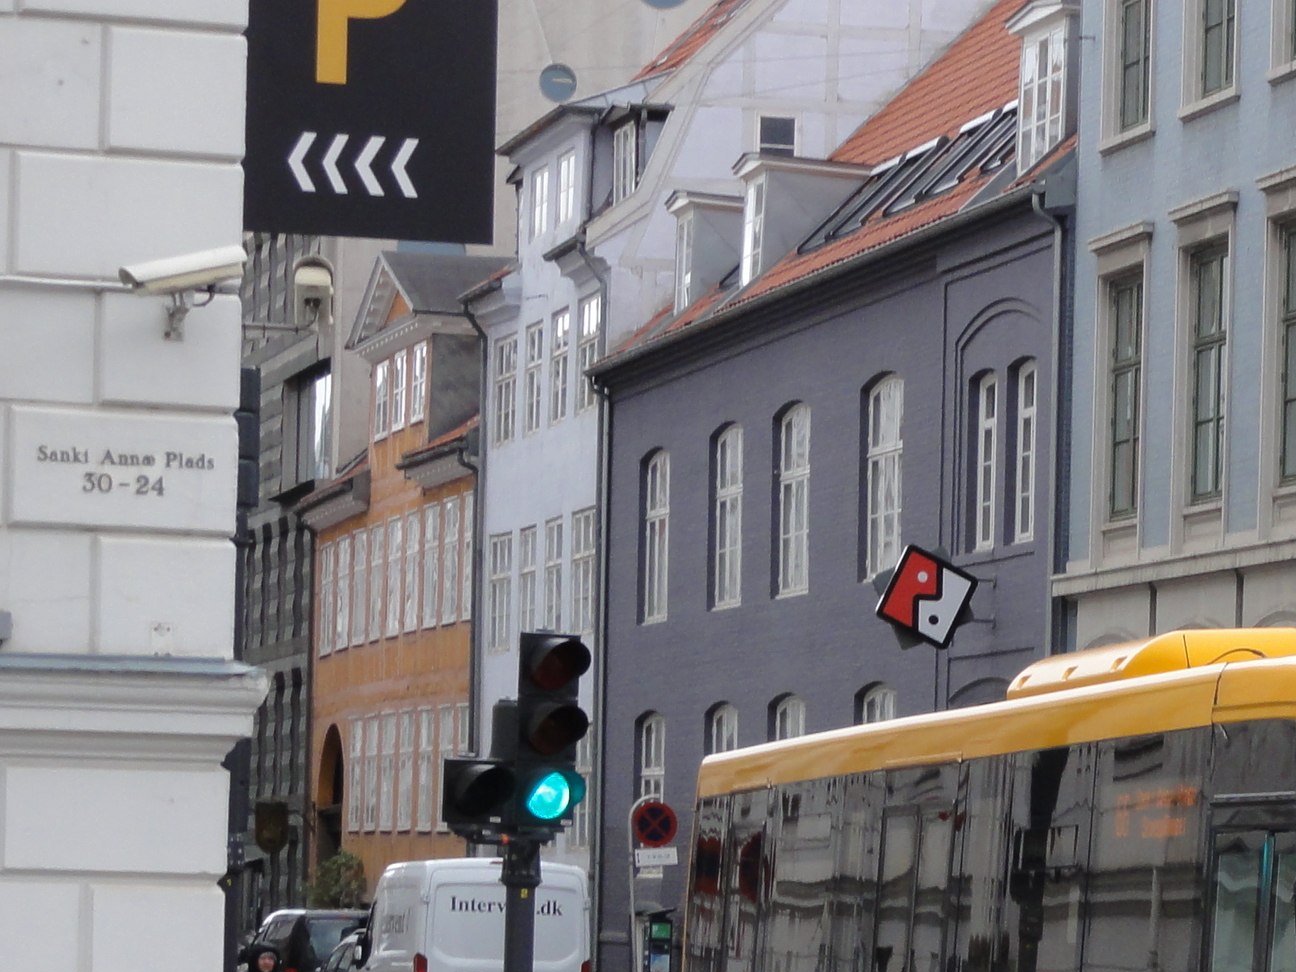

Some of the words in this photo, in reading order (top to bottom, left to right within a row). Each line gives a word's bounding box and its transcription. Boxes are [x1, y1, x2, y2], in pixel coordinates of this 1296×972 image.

[37, 445, 89, 464] Sankt
[100, 449, 156, 467] Annæ
[165, 451, 215, 470] Plads
